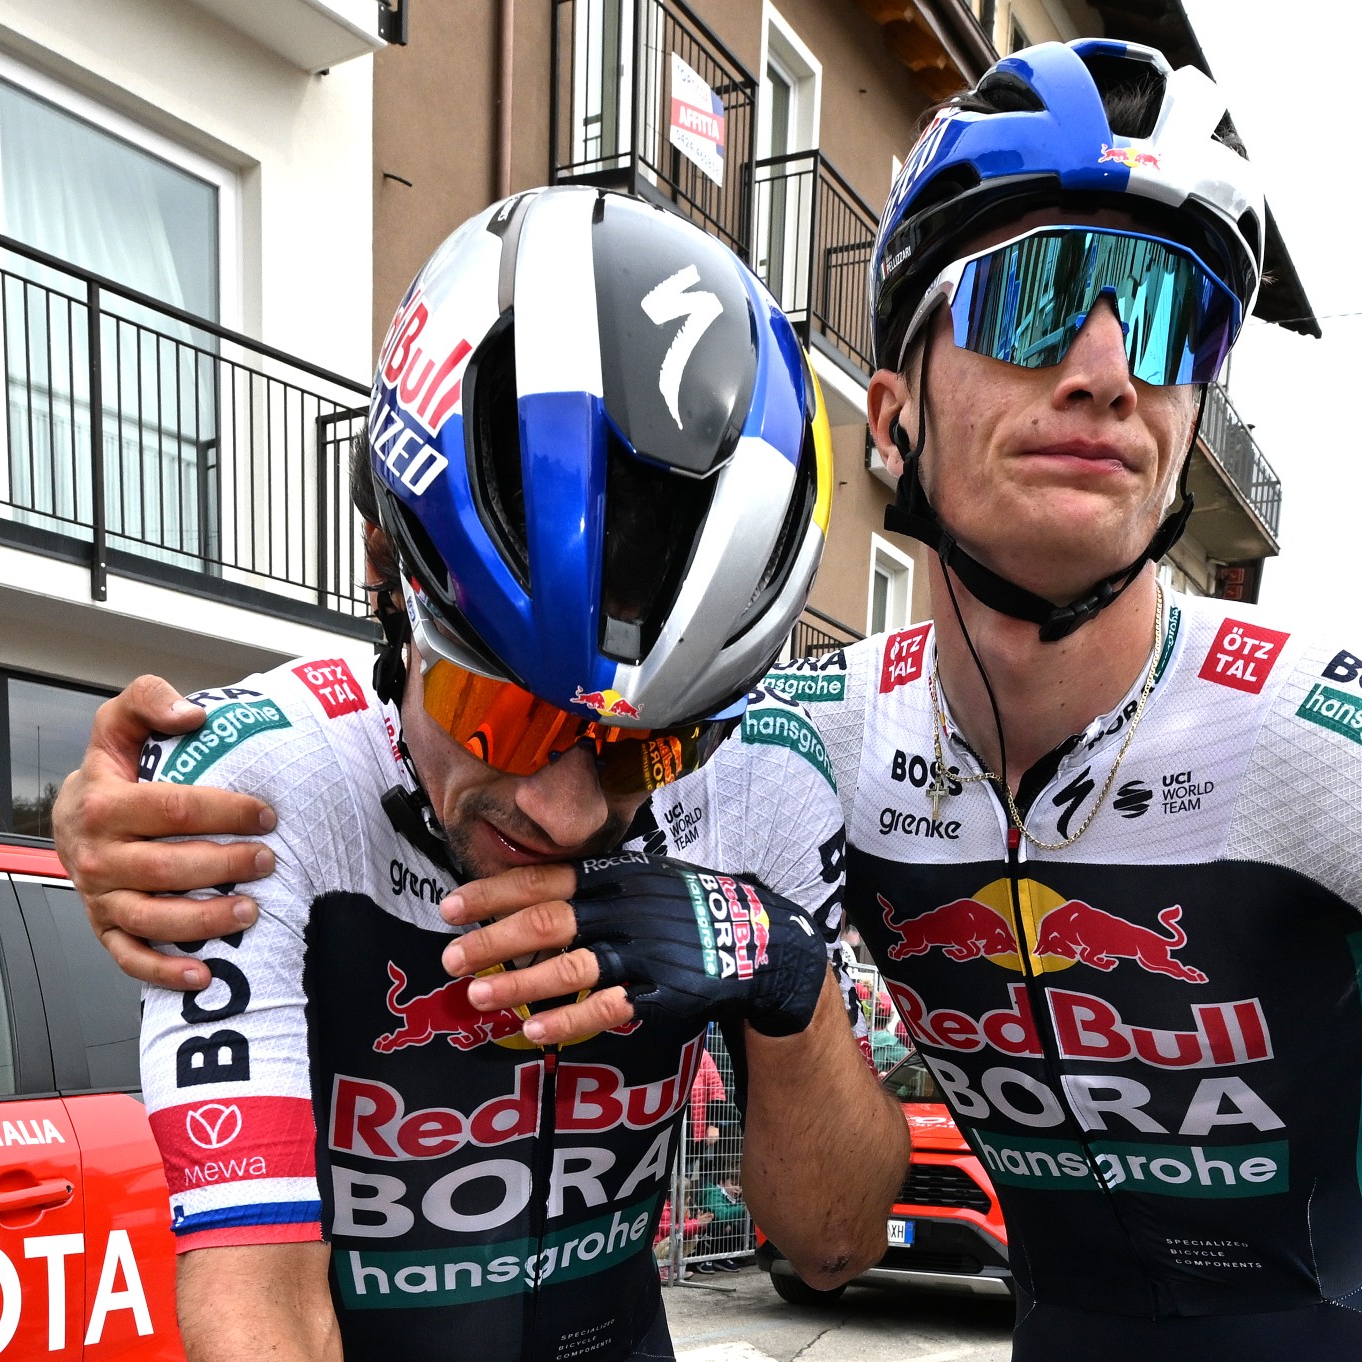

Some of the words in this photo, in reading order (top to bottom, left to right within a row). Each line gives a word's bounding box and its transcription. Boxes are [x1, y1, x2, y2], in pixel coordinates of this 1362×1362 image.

[679, 105, 720, 140] AFFITTA
[1224, 625, 1277, 664] ÖTZ
[1215, 652, 1261, 684] TAL
[158, 700, 281, 784] hansgrohe
[745, 708, 836, 784] hansgroh
[891, 749, 965, 797] BOSS
[1162, 772, 1193, 788] UCI
[1162, 780, 1215, 801] WORLD
[1162, 797, 1202, 816] TEAM
[664, 802, 685, 824] UCI
[669, 806, 703, 839] WORLD
[879, 807, 962, 840] grenke
[674, 829, 701, 852] TEAM
[390, 859, 446, 906] grenk
[686, 872, 717, 976] hansgrohe
[697, 873, 737, 979] BORA
[895, 974, 1049, 1059] Red
[1045, 986, 1275, 1071] Bull
[329, 1063, 544, 1159] Red
[553, 1027, 706, 1133] Bull
[930, 1056, 1288, 1136] BORA
[980, 1129, 1278, 1196] hansgrohe
[330, 1126, 677, 1241] BORA
[352, 1205, 651, 1297] hansgrohe
[1165, 1238, 1249, 1248] SPECIALIZED
[1169, 1248, 1226, 1257] BICYCLE
[1175, 1258, 1262, 1268] COMPONENTS
[558, 1335, 598, 1351] BICYCLE
[560, 1318, 615, 1341] SPECIALIZED
[556, 1337, 613, 1361] COMPONENTS
